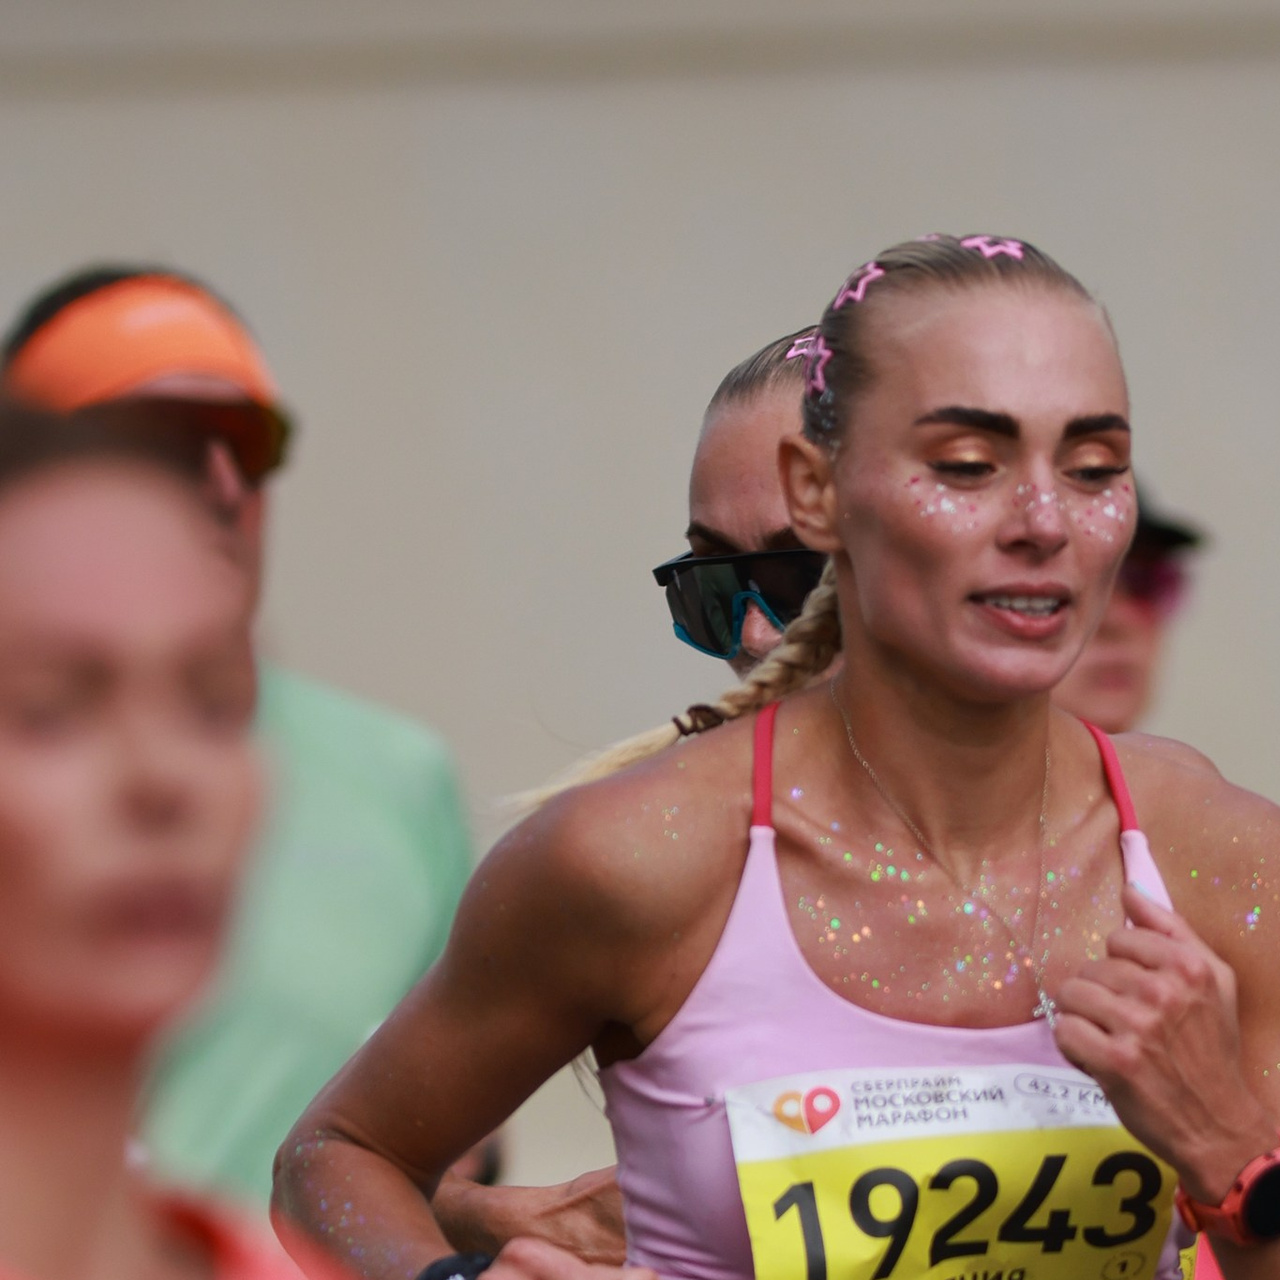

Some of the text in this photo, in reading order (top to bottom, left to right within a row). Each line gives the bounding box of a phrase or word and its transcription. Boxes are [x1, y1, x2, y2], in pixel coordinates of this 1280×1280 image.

[851, 1075, 961, 1094] СБЕРПРАЙМ
[854, 1084, 1006, 1110] МОСКОВСКИЙ
[856, 1106, 969, 1129] МАРАФОН
